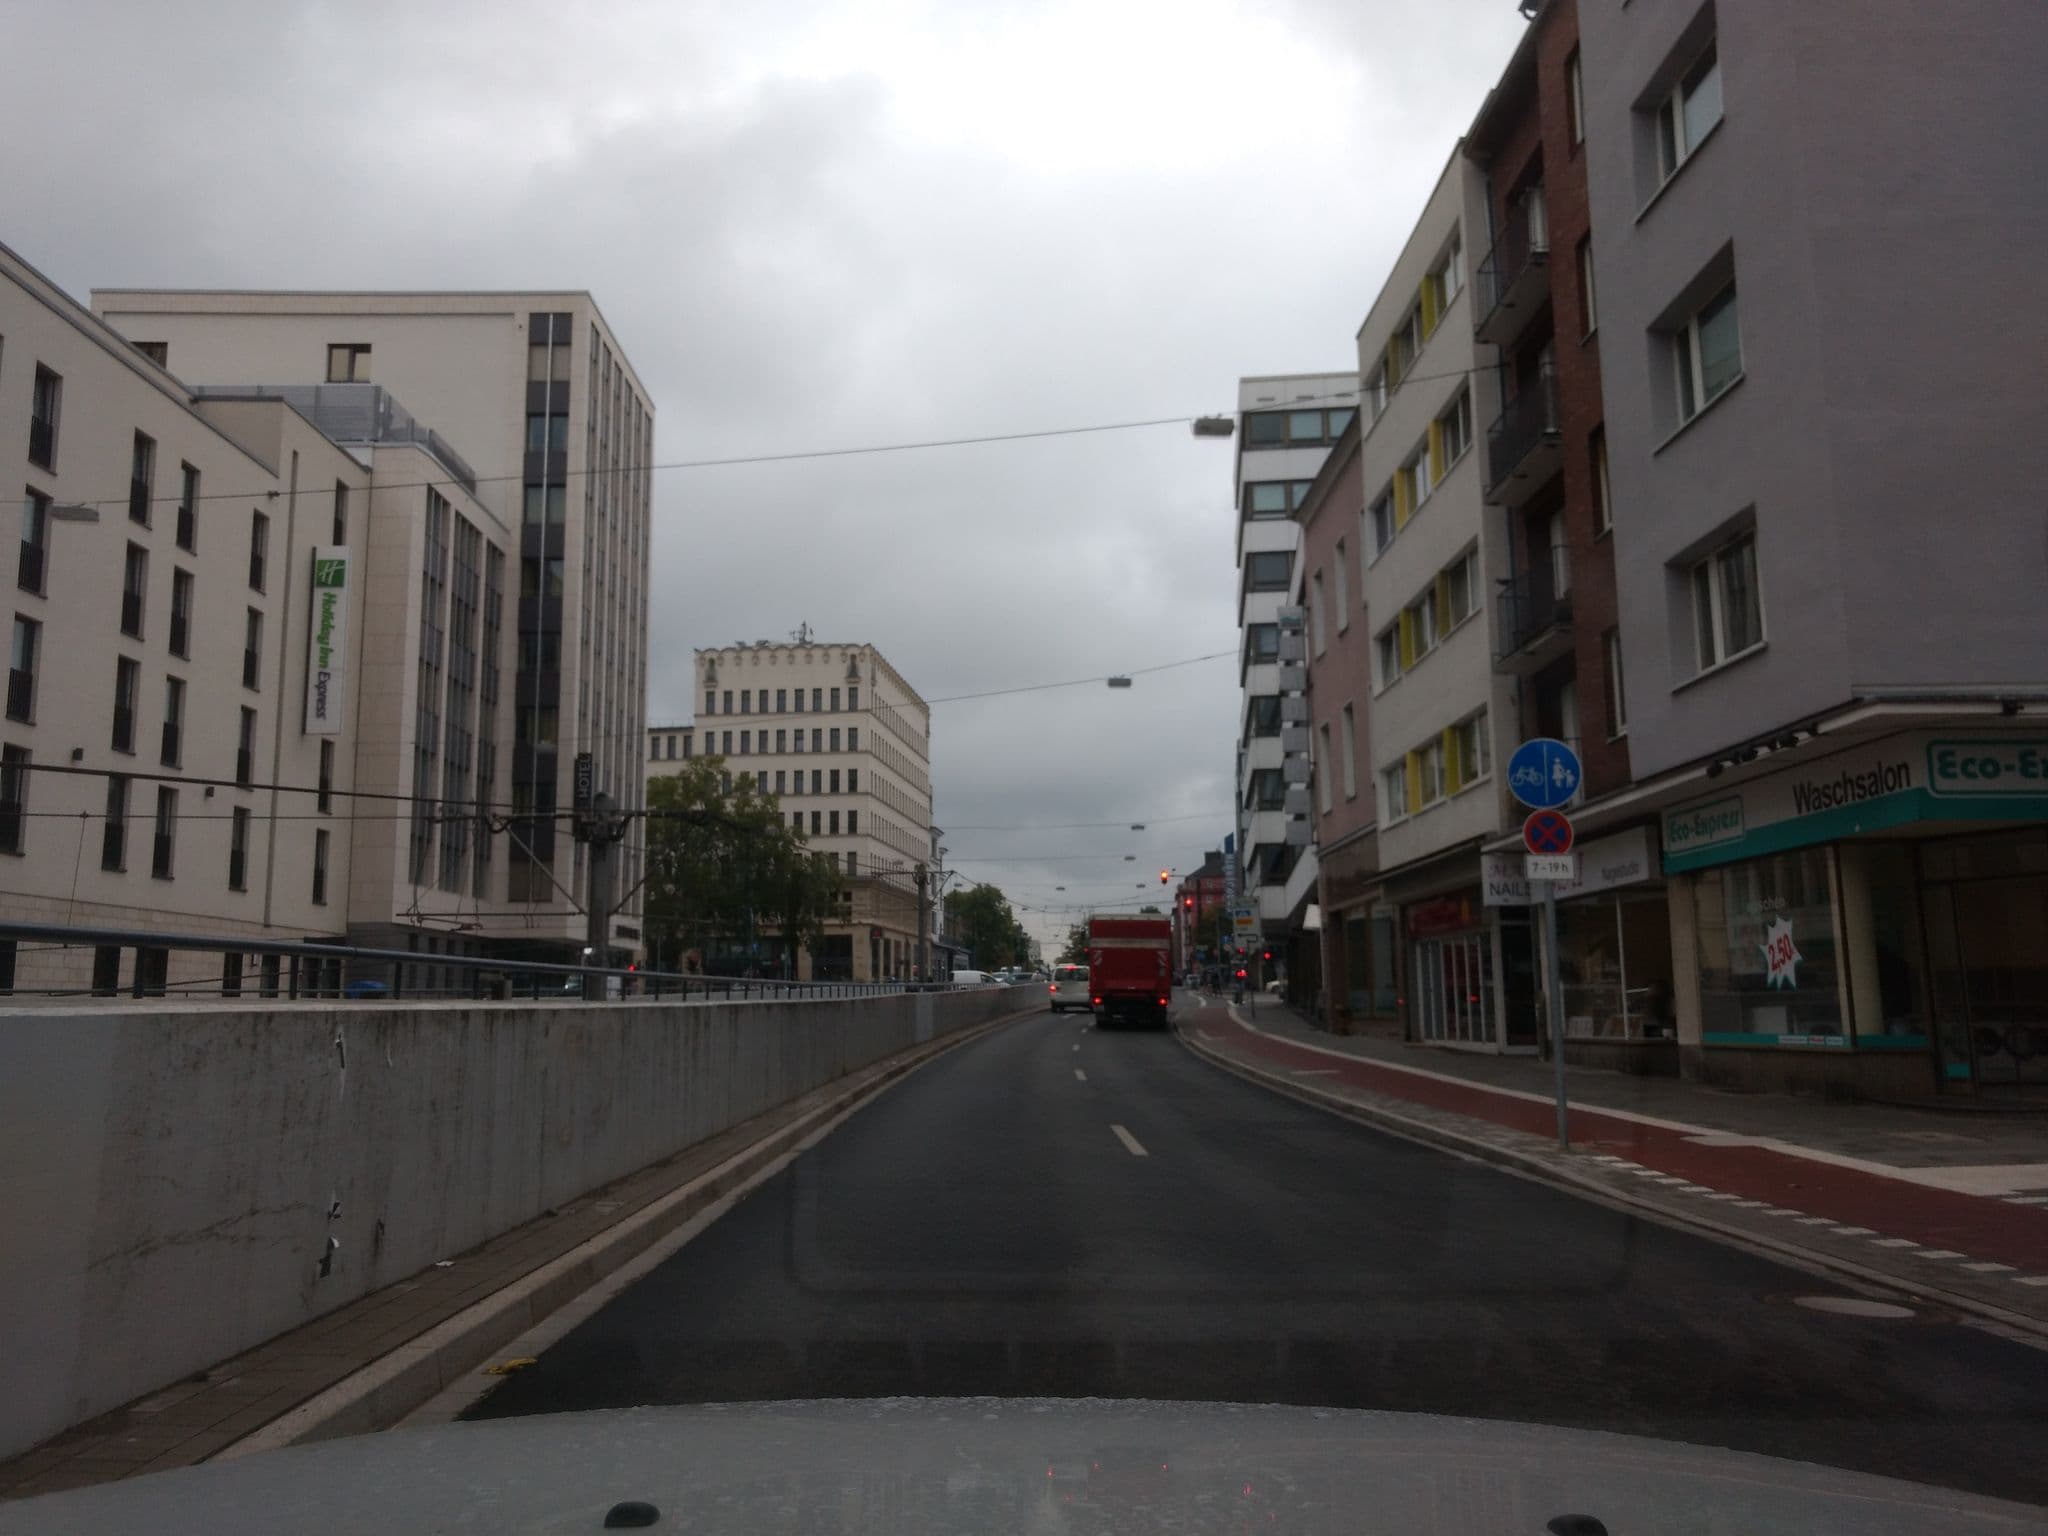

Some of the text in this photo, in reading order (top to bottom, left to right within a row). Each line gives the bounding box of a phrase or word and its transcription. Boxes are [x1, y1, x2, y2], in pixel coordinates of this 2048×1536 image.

[315, 592, 338, 720] Holiday Inn Express
[578, 754, 591, 798] HOTEL
[1792, 760, 1911, 815] Waschsalon
[1670, 809, 1739, 843] Eco-Express
[1767, 933, 1793, 974] 2,50
